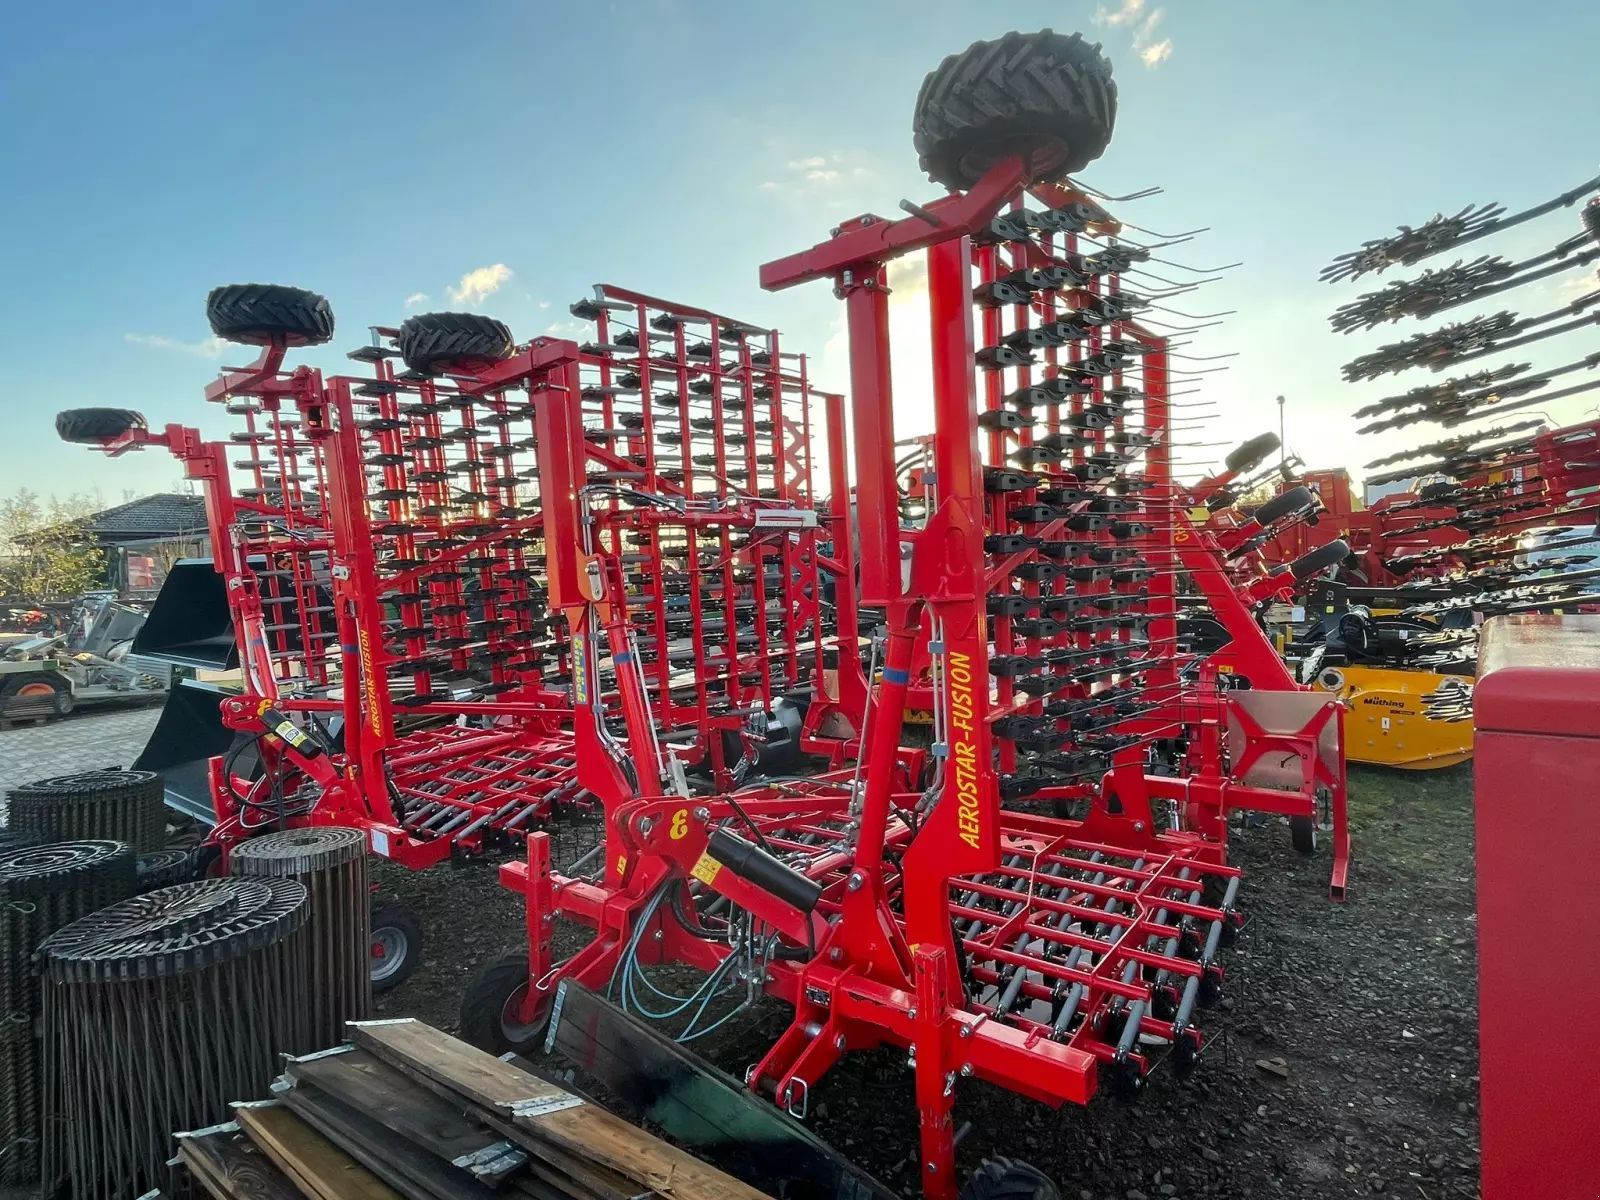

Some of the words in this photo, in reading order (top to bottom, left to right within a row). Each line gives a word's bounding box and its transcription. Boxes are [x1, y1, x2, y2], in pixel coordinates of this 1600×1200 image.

[360, 629, 381, 738] AEROSTAR-FUSION
[1363, 696, 1405, 708] Müthing
[949, 651, 980, 850] AEROSTAR-FUSION
